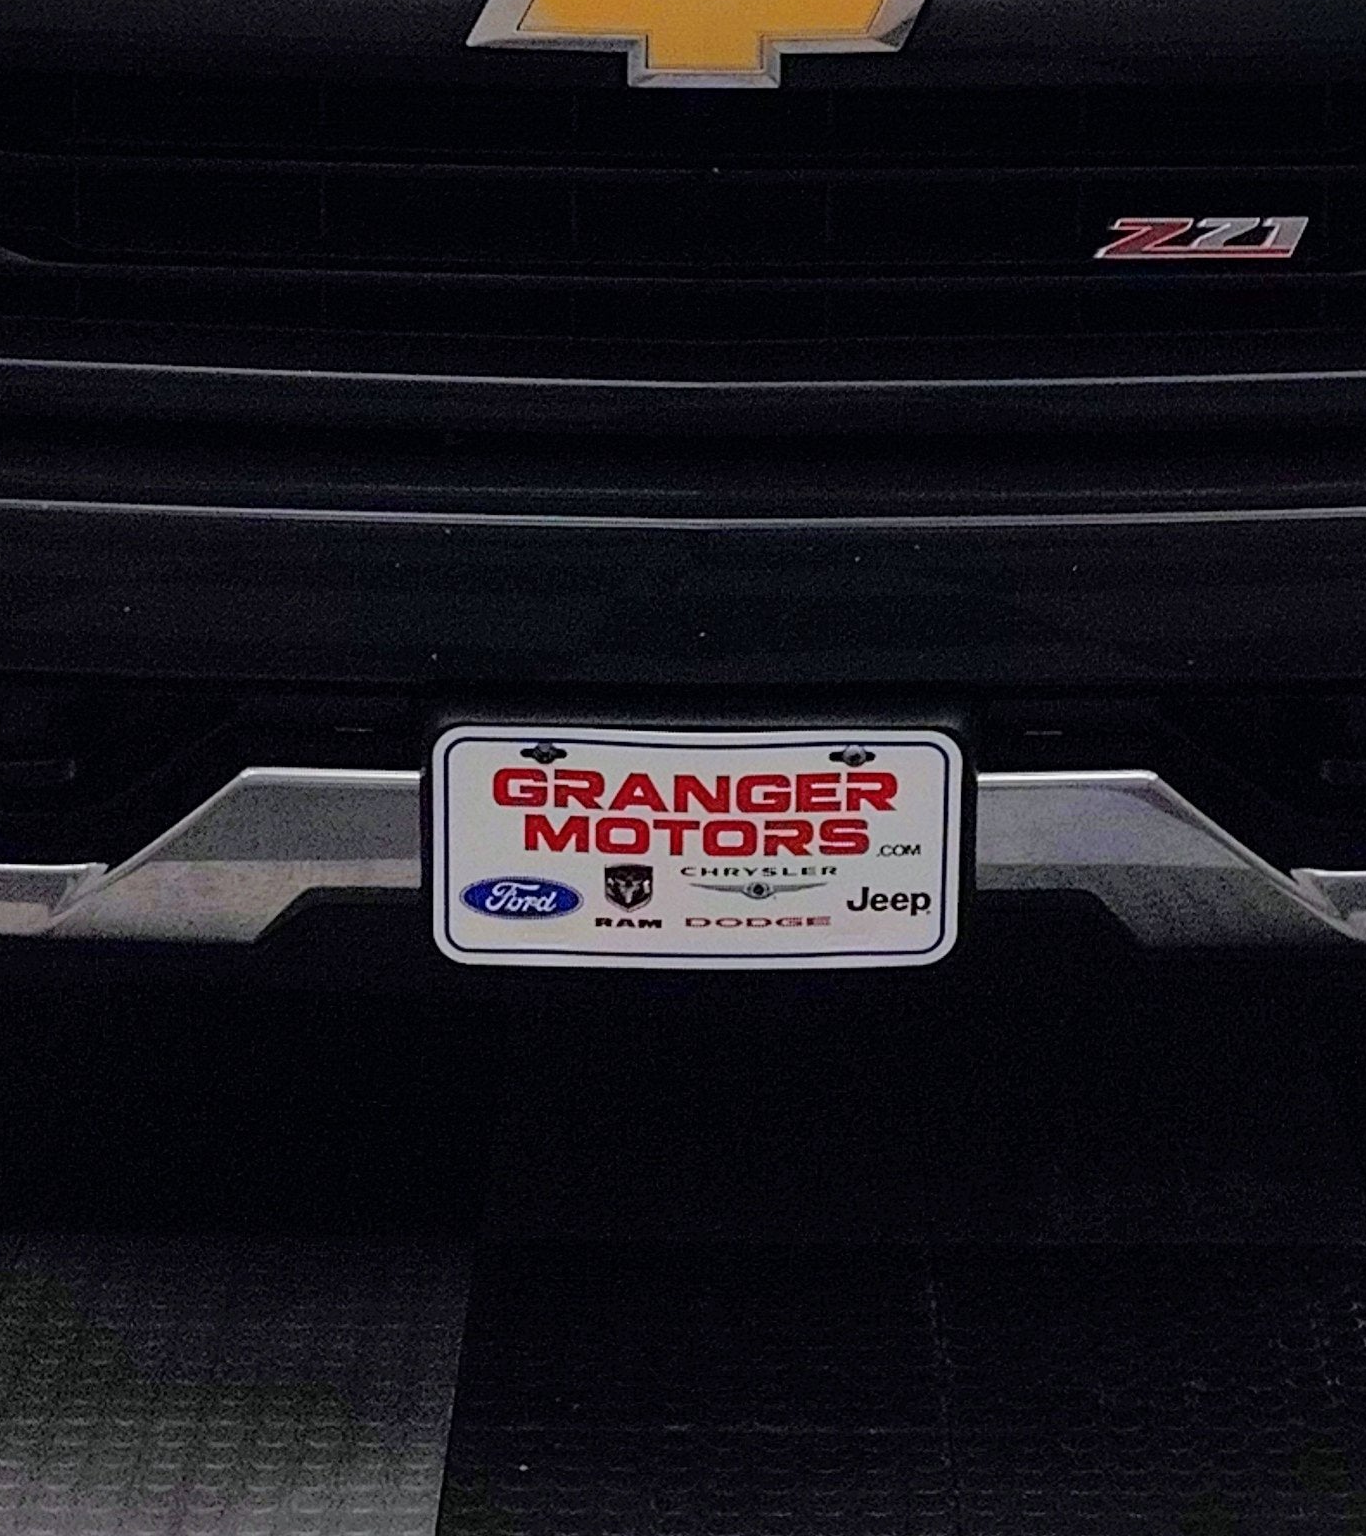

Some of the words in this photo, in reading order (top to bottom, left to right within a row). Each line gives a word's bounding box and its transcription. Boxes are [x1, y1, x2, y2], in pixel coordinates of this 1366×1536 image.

[492, 767, 898, 813] GRANGER
[524, 813, 870, 857] MOTORS
[680, 866, 838, 878] CHRYSLER
[485, 881, 557, 914] Ford
[846, 886, 932, 916] Jeep
[594, 917, 663, 929] RAM
[684, 916, 832, 928] DODGE
